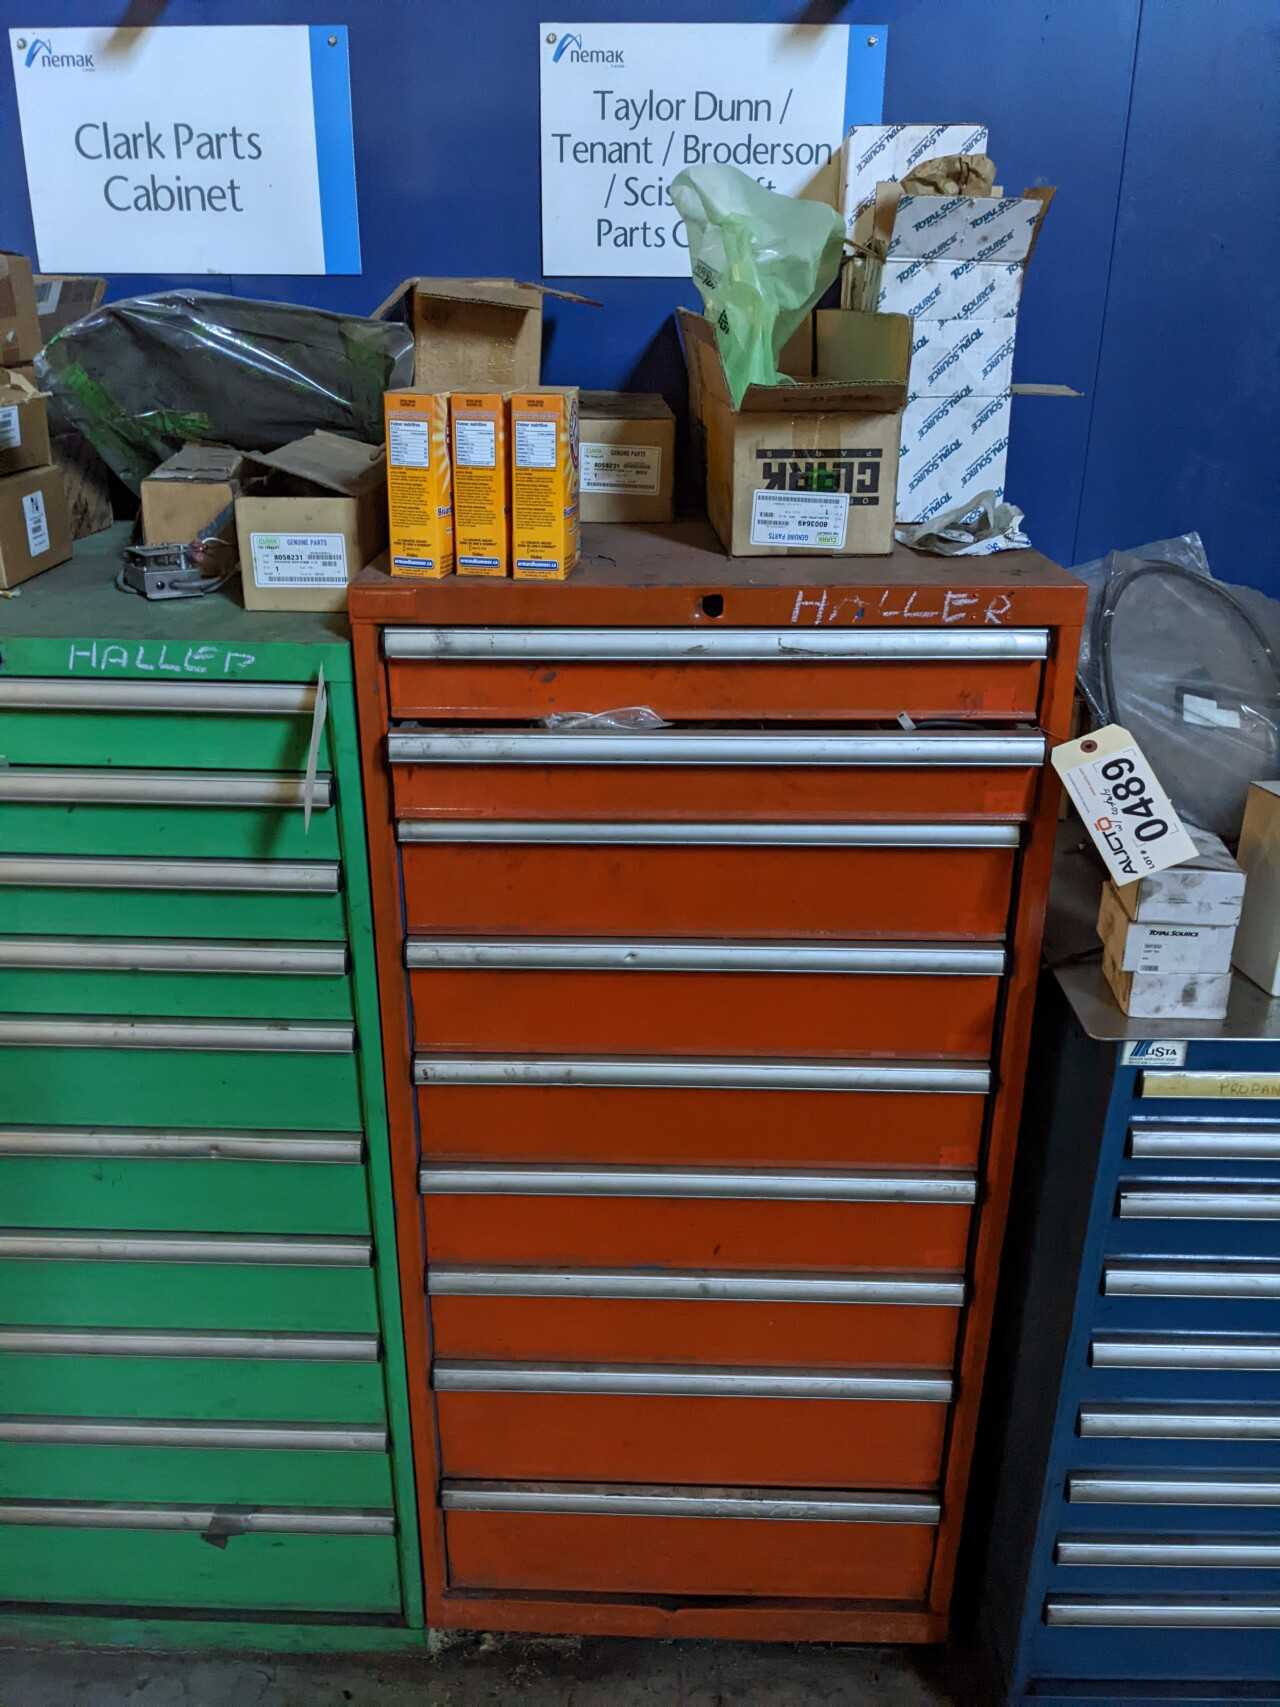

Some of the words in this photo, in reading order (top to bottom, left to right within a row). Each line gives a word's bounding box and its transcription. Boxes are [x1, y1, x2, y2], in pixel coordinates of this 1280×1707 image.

[593, 89, 686, 131] Taylor
[694, 90, 772, 122] Dunn
[779, 88, 794, 125] /
[74, 123, 164, 161] Clark
[175, 123, 263, 161] Parts
[552, 133, 654, 164] Tenant
[662, 131, 676, 167] /
[683, 133, 833, 165] Broderson
[103, 175, 244, 212] Cabinet
[603, 173, 617, 210] /
[597, 218, 666, 249] Parts
[762, 461, 881, 493] CLARK
[1101, 757, 1169, 843] 0489
[1143, 857, 1156, 870] LOT
[1146, 1046, 1177, 1057] LISTA
